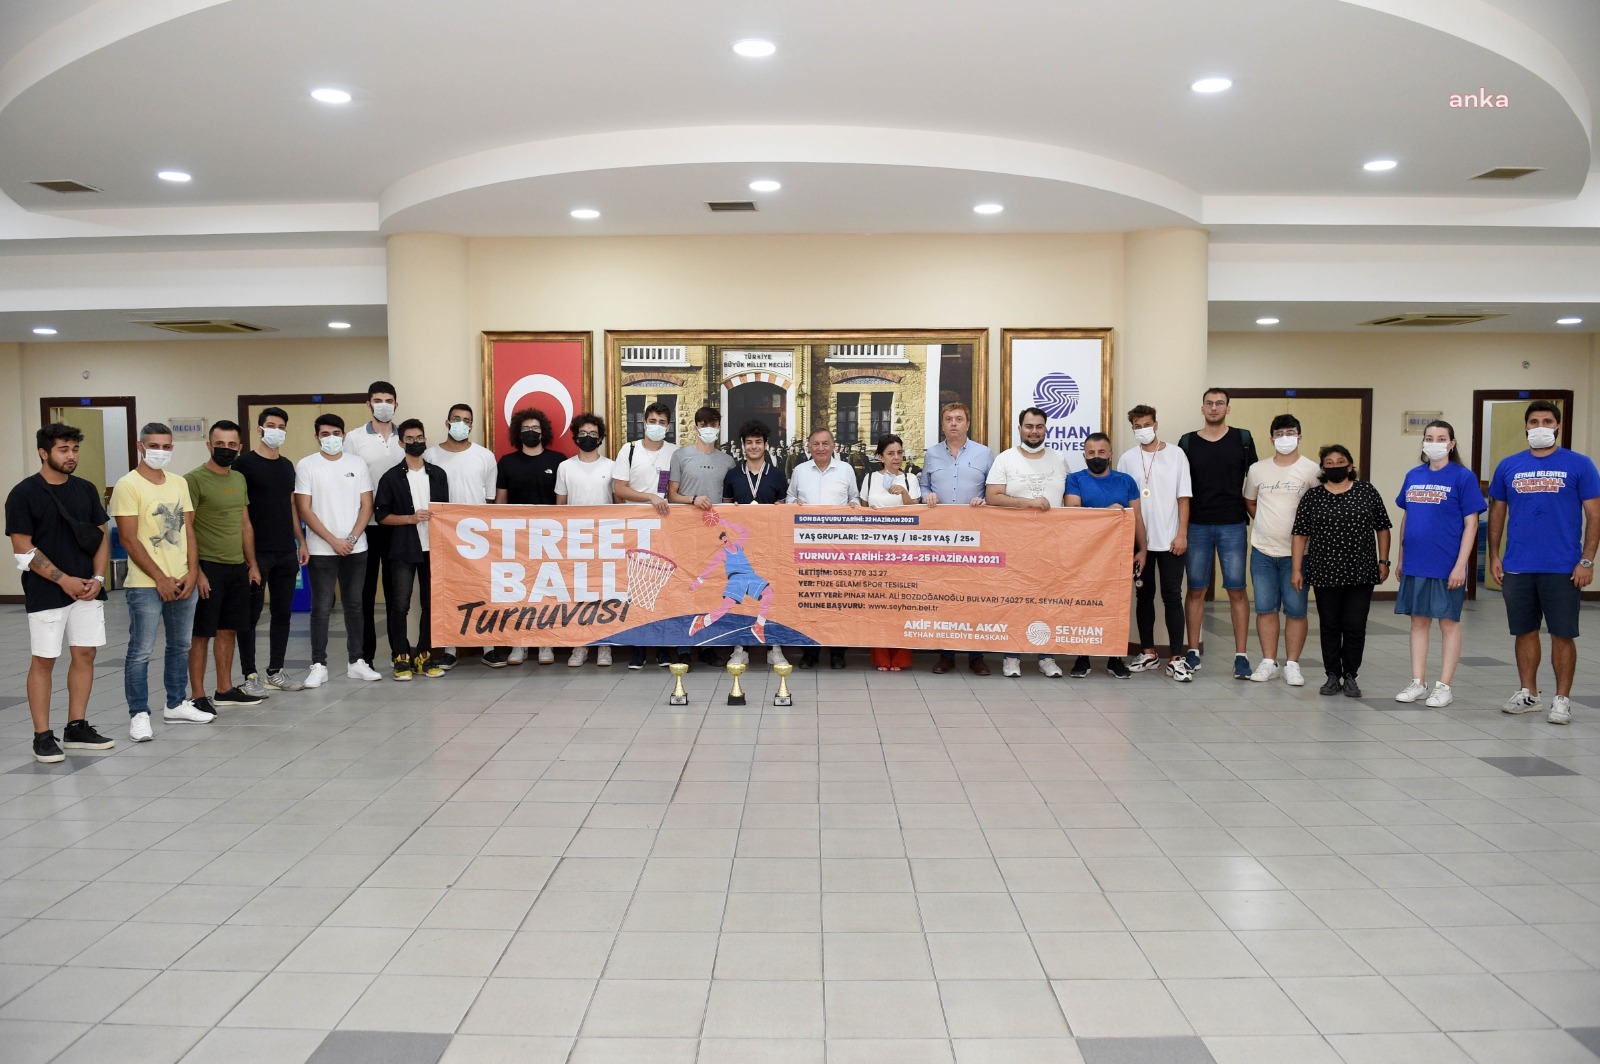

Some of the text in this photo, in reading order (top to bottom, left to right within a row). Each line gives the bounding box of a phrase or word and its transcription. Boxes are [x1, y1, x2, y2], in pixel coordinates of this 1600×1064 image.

[1045, 426, 1091, 439] YHAN
[1044, 440, 1086, 451] EDİYES
[812, 516, 841, 524] BAŞVURU
[455, 518, 661, 560] STREET
[799, 533, 815, 541] YAŞ
[882, 534, 899, 543] YAŞ
[909, 534, 932, 542] 18-25
[934, 535, 950, 544] YAŞ
[799, 551, 1000, 564] TURNUVA TARİHİ: 23-24-25 HAZİRAN 2021
[490, 562, 629, 603] BALL
[798, 591, 821, 599] KAYIT
[901, 593, 964, 602] BOZDOĞANOĞLU
[966, 595, 999, 603] BULVARI
[1038, 597, 1073, 606] SEYHAN/
[826, 602, 866, 611] BAŞVURU:
[868, 603, 938, 612] www.seyhan.bel.tr
[904, 619, 1008, 632] AKİF KEMAL AKAY
[1055, 625, 1104, 636] SEYHAN
[936, 632, 972, 640] BELEDİYE
